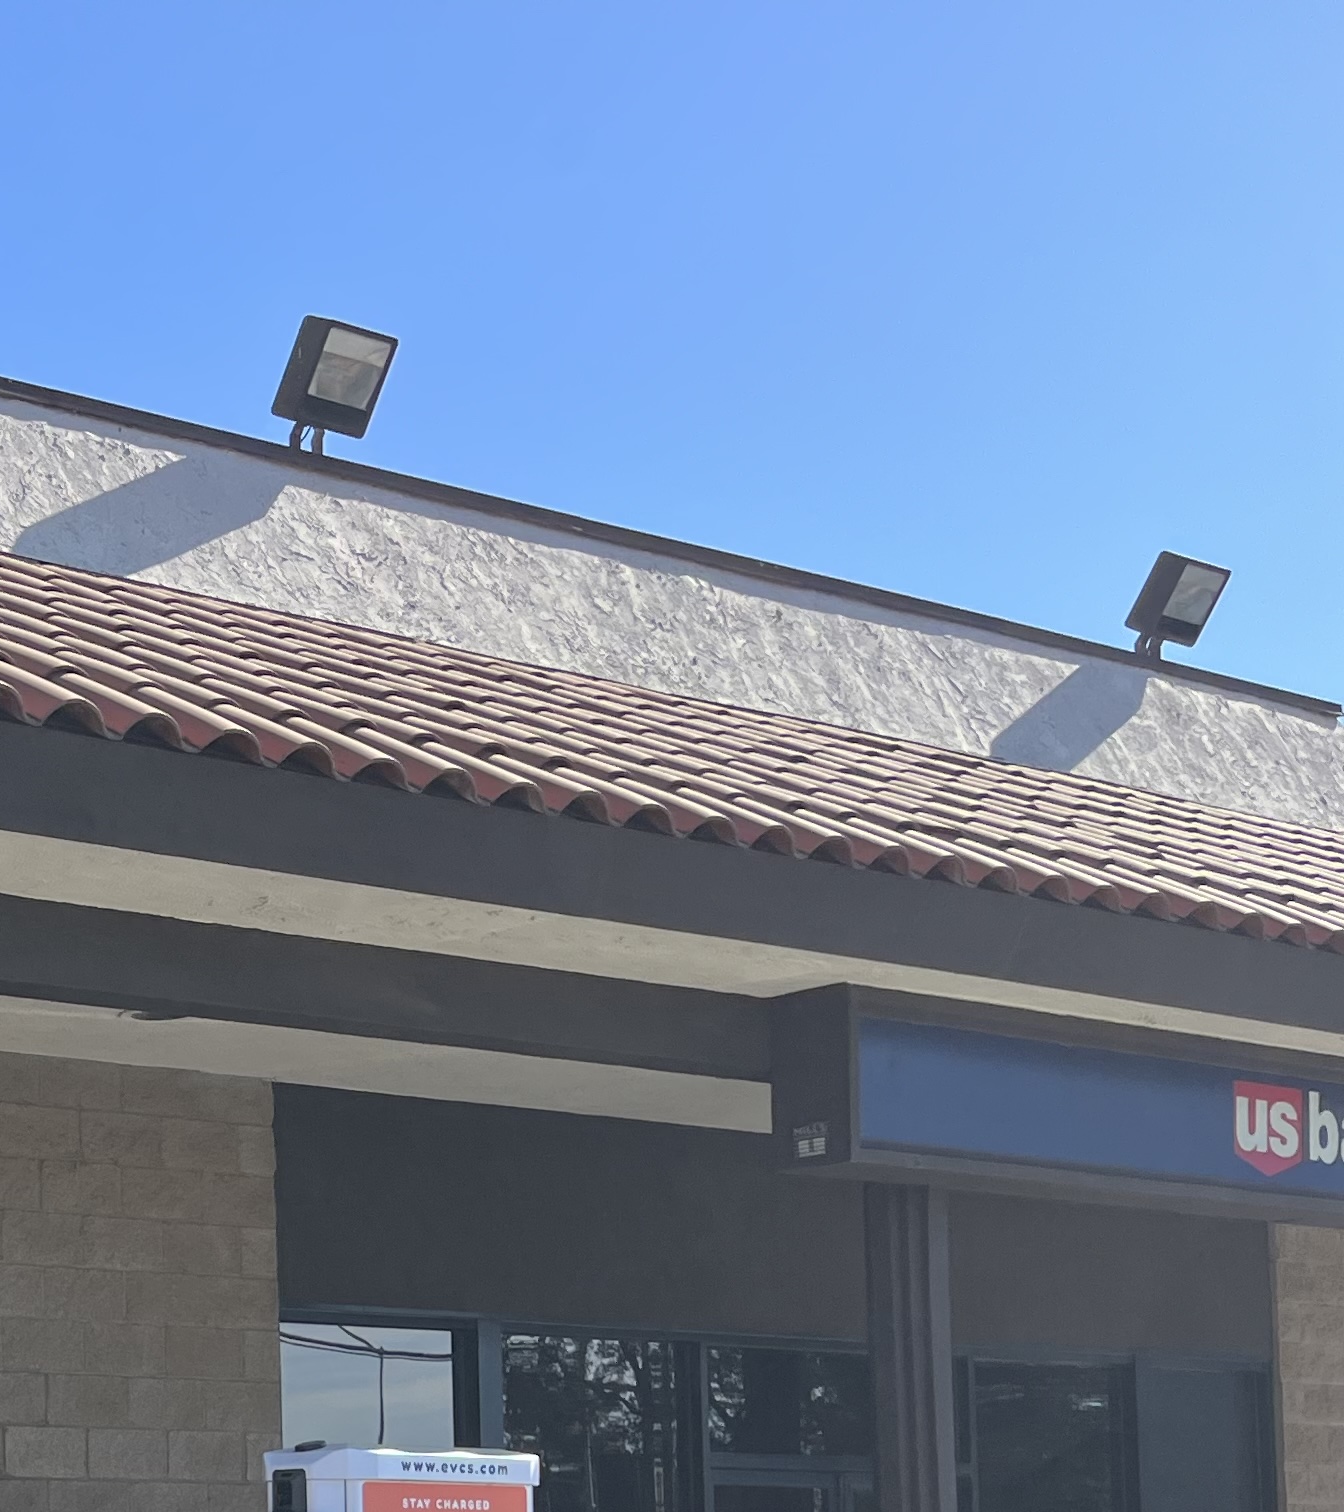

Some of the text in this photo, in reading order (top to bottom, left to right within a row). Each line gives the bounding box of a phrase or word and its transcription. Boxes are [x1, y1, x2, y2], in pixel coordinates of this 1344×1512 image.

[1236, 1090, 1344, 1164] us b
[401, 1461, 508, 1475] www.evcs.com
[402, 1498, 490, 1511] STAY CHARGED
